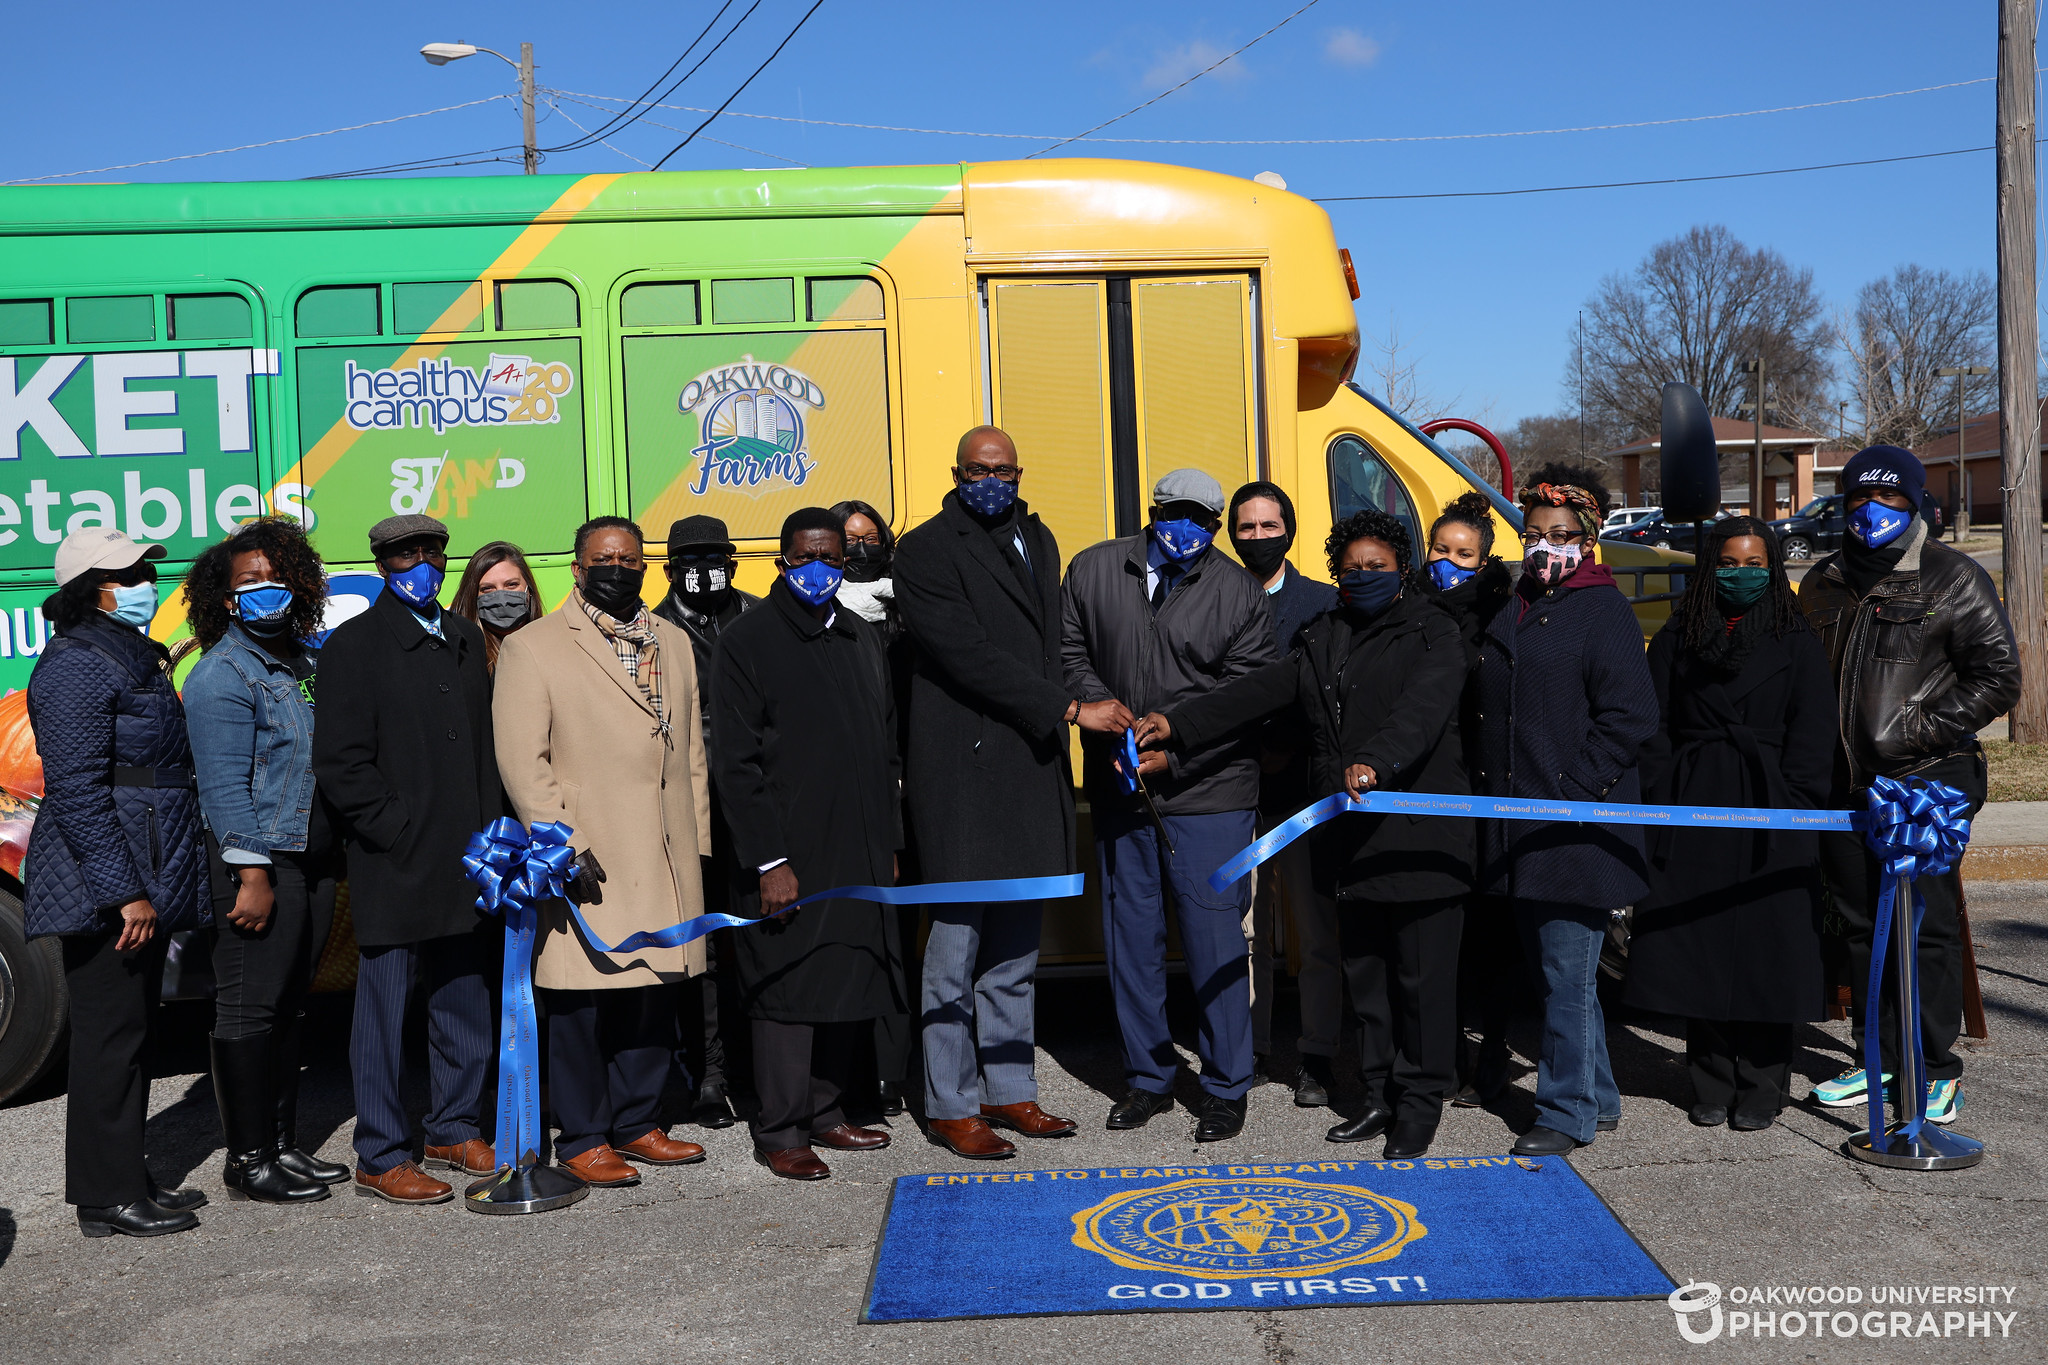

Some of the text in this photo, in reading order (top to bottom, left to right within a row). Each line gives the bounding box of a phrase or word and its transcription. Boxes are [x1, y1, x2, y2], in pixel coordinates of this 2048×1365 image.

[348, 359, 571, 403] healthy A+ 20
[678, 365, 825, 414] OAKWOOD
[0, 348, 282, 460] KET
[348, 392, 554, 432] campus 20
[688, 436, 817, 495] Farms
[1859, 468, 1881, 482] all
[1872, 519, 1901, 538] Oakwood
[685, 579, 700, 593] US
[1393, 799, 1472, 811] Oakwood University
[1494, 804, 1572, 816] Oakwood University
[1593, 809, 1671, 820] Oakwood University
[1692, 812, 1771, 823] Oakwood University
[1792, 816, 1828, 824] Oakwood
[1251, 833, 1287, 858] University
[520, 963, 529, 1001] Oakwood
[507, 1013, 517, 1051] Oakwood
[503, 1072, 515, 1154] Oakwood University
[524, 1064, 534, 1145] Oakwood University
[926, 1157, 1537, 1186] ENTER TO LEARN, DEPART TO SERVE
[1110, 1186, 1382, 1226] OAKWOOD UNIVERSITY
[1113, 1223, 1382, 1267] HUNTSVILLE ALABAMA
[1215, 1241, 1292, 1253] 18 96
[1107, 1275, 1428, 1299] GOD FIRST!
